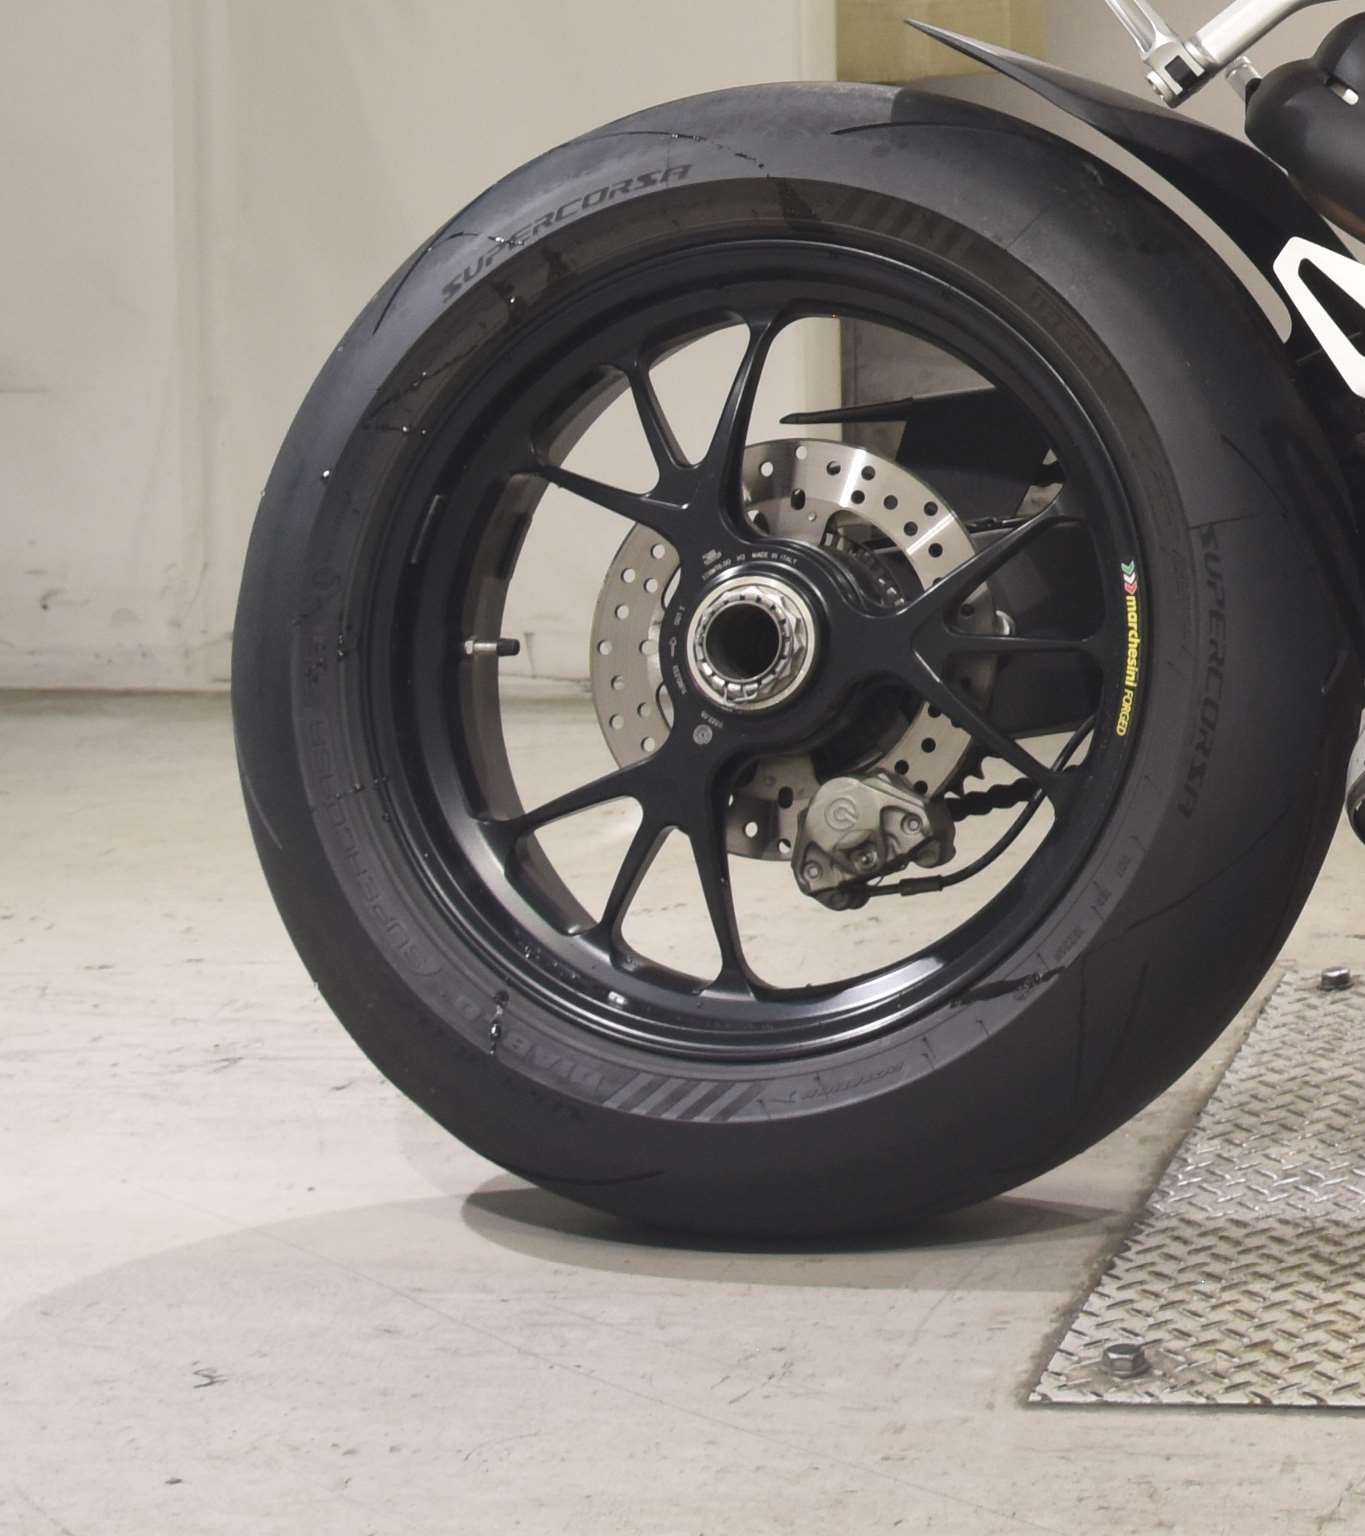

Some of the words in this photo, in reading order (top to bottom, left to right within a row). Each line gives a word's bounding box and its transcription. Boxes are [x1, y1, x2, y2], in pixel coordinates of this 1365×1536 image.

[440, 163, 696, 305] SUPERCORSA
[1124, 595, 1142, 688] marchesini
[1176, 524, 1228, 820] SUPERCORSA
[1115, 688, 1134, 736] FORGED
